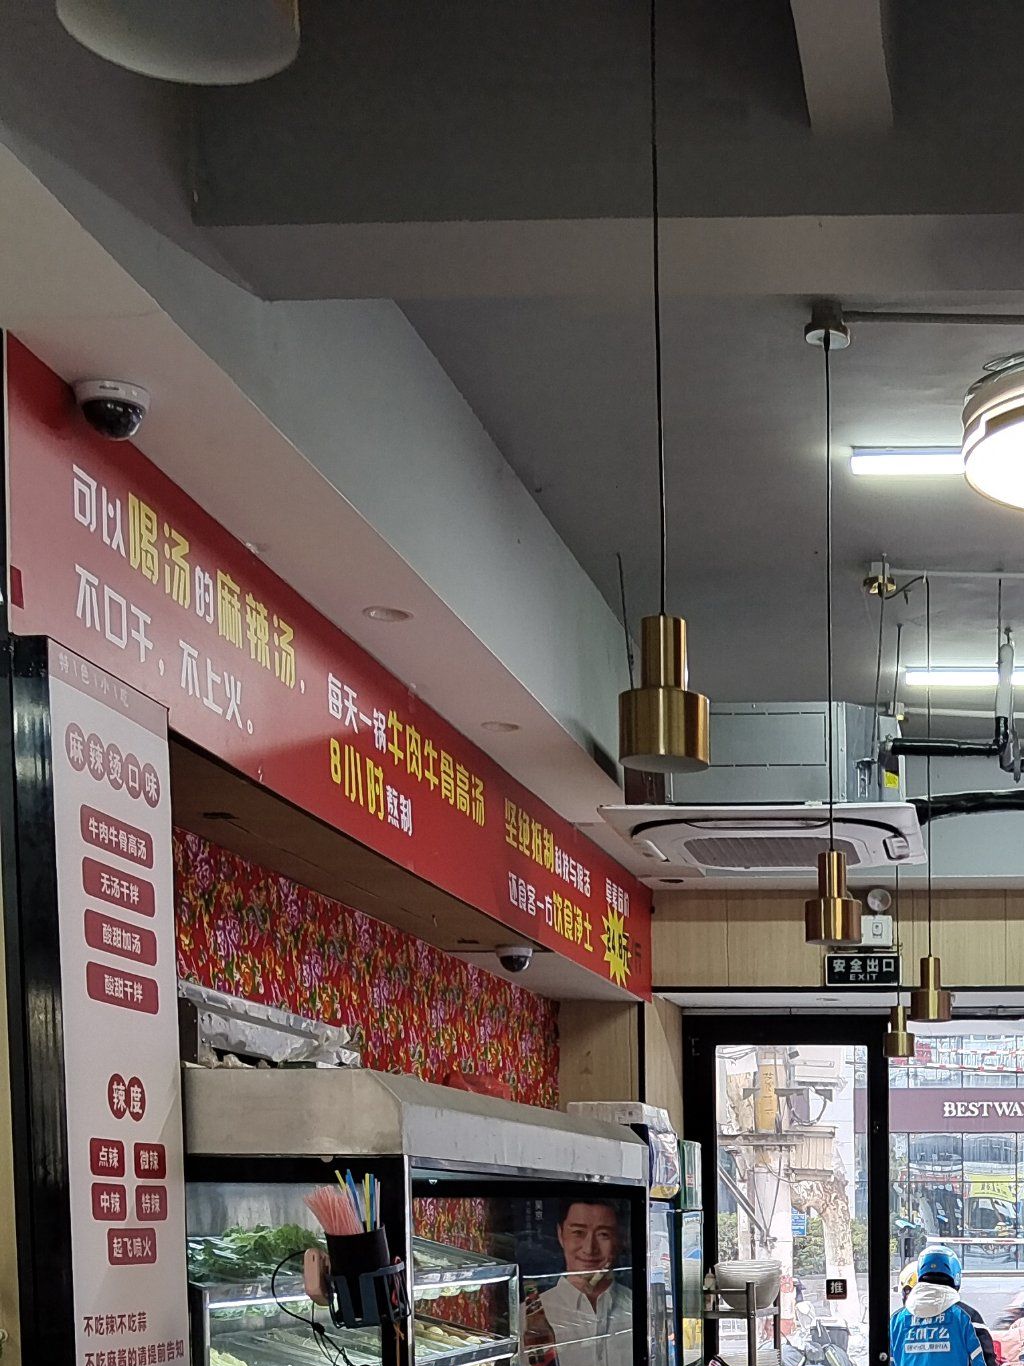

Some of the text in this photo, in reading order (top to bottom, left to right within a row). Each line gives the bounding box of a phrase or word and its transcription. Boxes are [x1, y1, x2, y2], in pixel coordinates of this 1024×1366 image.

[327, 672, 486, 827] 每天一锅牛肉牛骨高汤
[69, 731, 158, 801] 麻辣烫口味
[329, 737, 413, 837] 8小时熬制
[88, 816, 147, 861] 牛肉牛骨高汤
[100, 872, 139, 905] 无汤干拌
[102, 923, 141, 956] 酸甜加汤
[832, 958, 895, 973] 安全出口
[849, 973, 878, 981] EXIT
[104, 973, 144, 1004] 酸甜干拌
[113, 1080, 144, 1115] 辣度
[98, 1146, 119, 1168] 点辣
[139, 1149, 159, 1171] 微辣
[100, 1191, 121, 1213] 中辣
[141, 1192, 161, 1214] 特辣
[112, 1236, 153, 1258] 起飞喷火
[830, 1281, 844, 1294] 推
